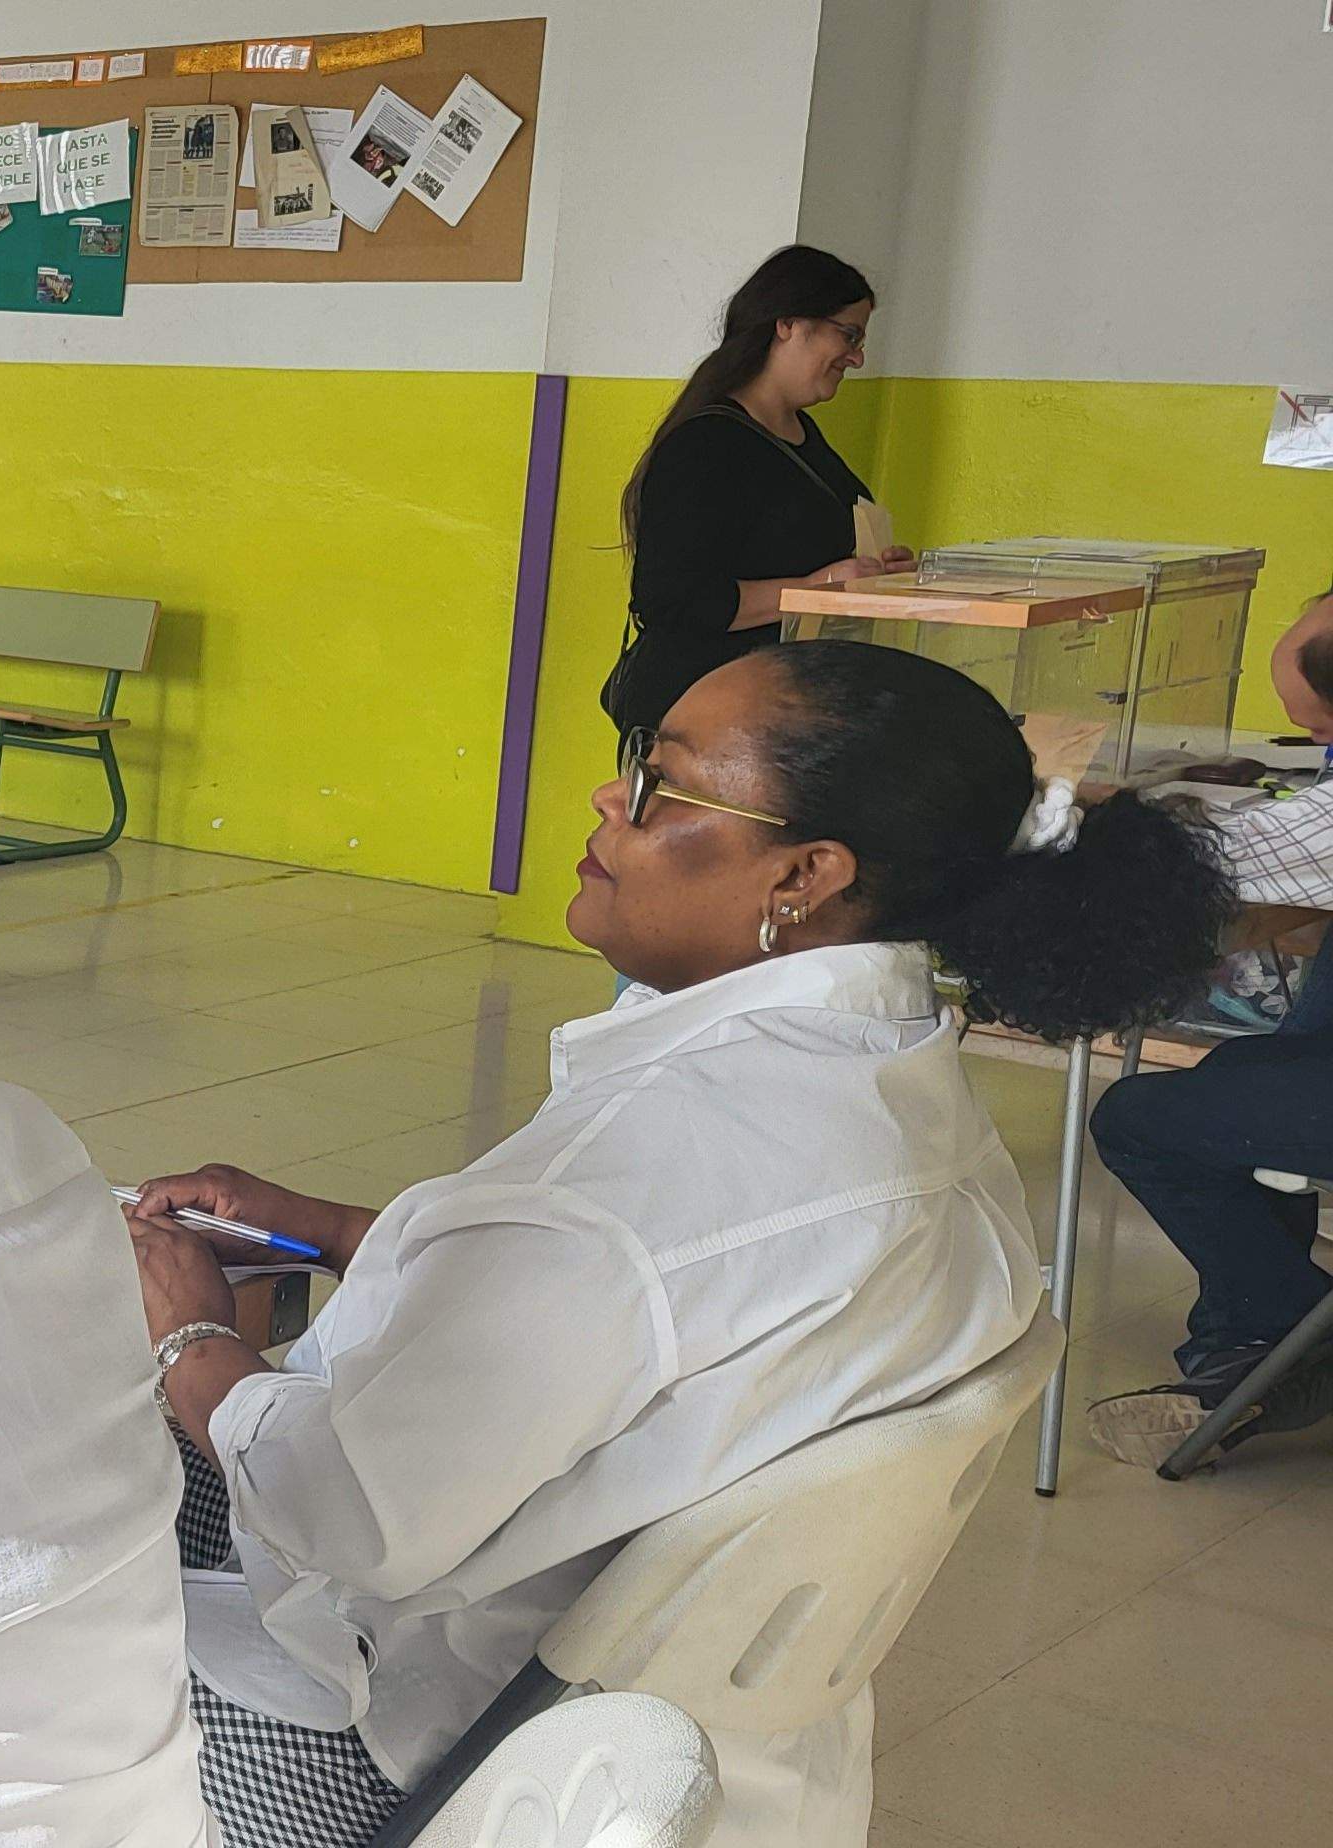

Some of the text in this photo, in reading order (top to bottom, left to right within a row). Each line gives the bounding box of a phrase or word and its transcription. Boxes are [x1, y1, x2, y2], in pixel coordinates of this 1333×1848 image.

[58, 133, 108, 152] ASTA
[56, 152, 111, 174] QUE SE
